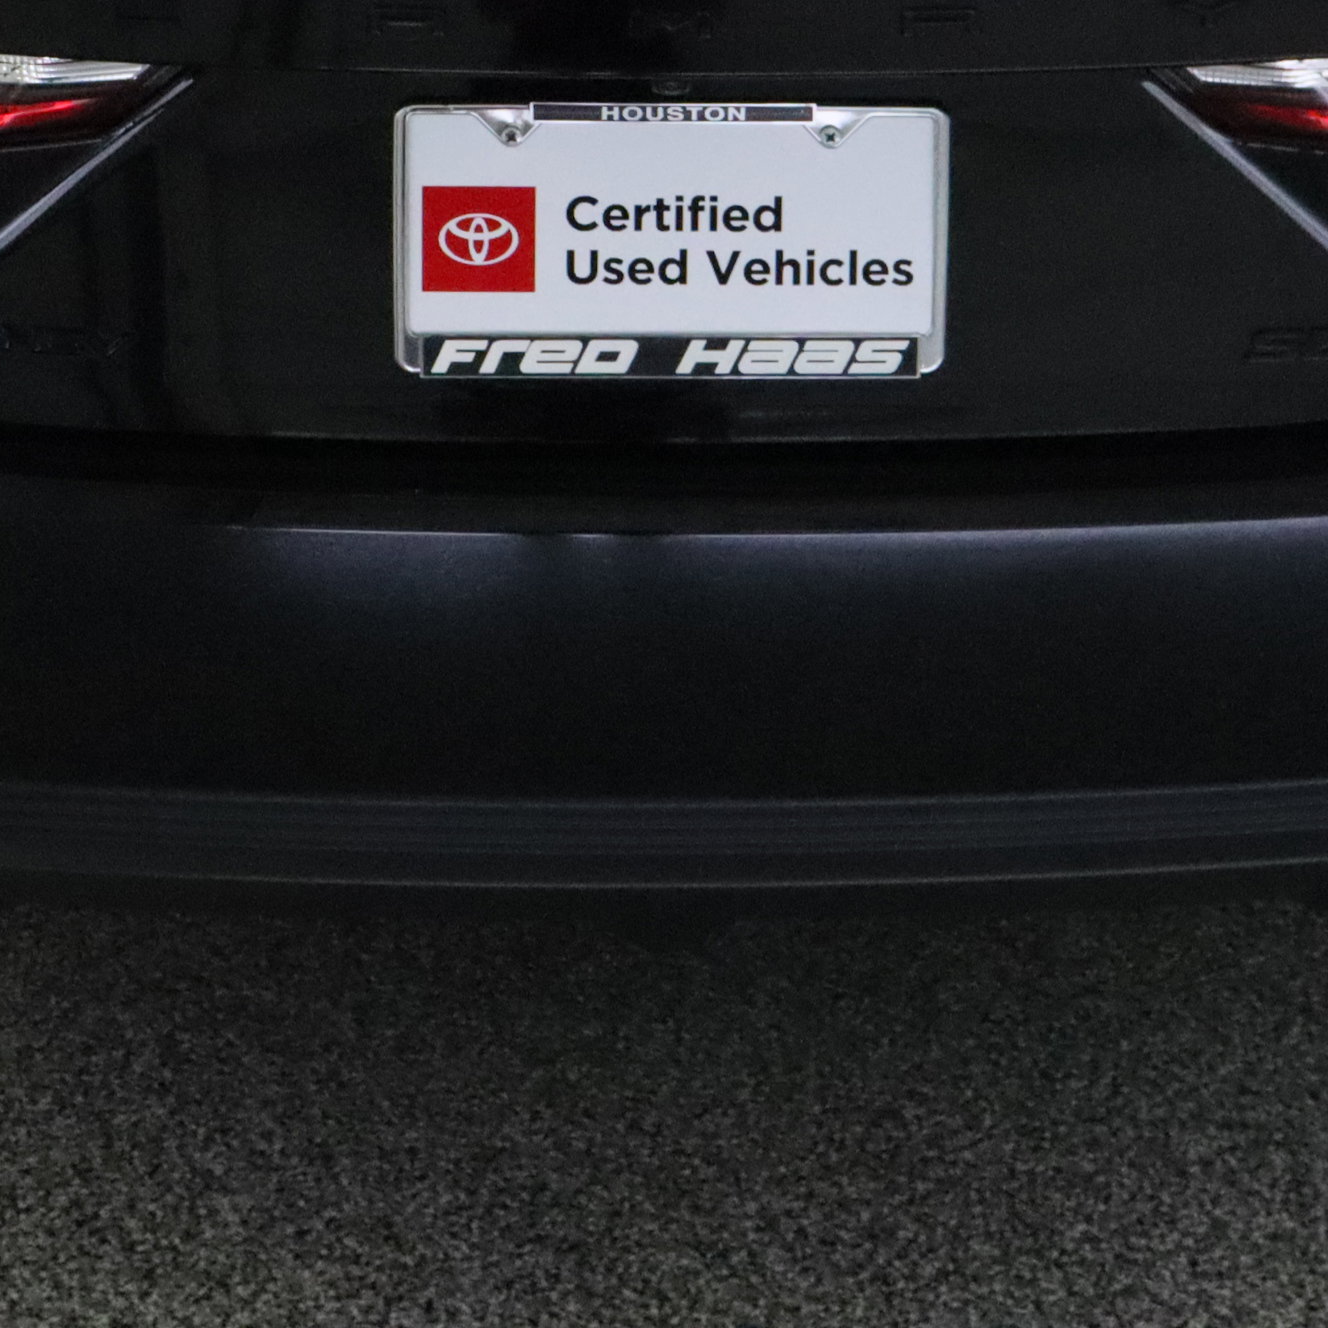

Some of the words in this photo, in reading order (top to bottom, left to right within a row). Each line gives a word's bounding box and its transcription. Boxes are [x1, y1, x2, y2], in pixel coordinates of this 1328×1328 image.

[600, 105, 747, 122] HOUSTON
[565, 195, 783, 233] Certified
[565, 249, 688, 286] Used
[706, 249, 915, 287] Vehicles
